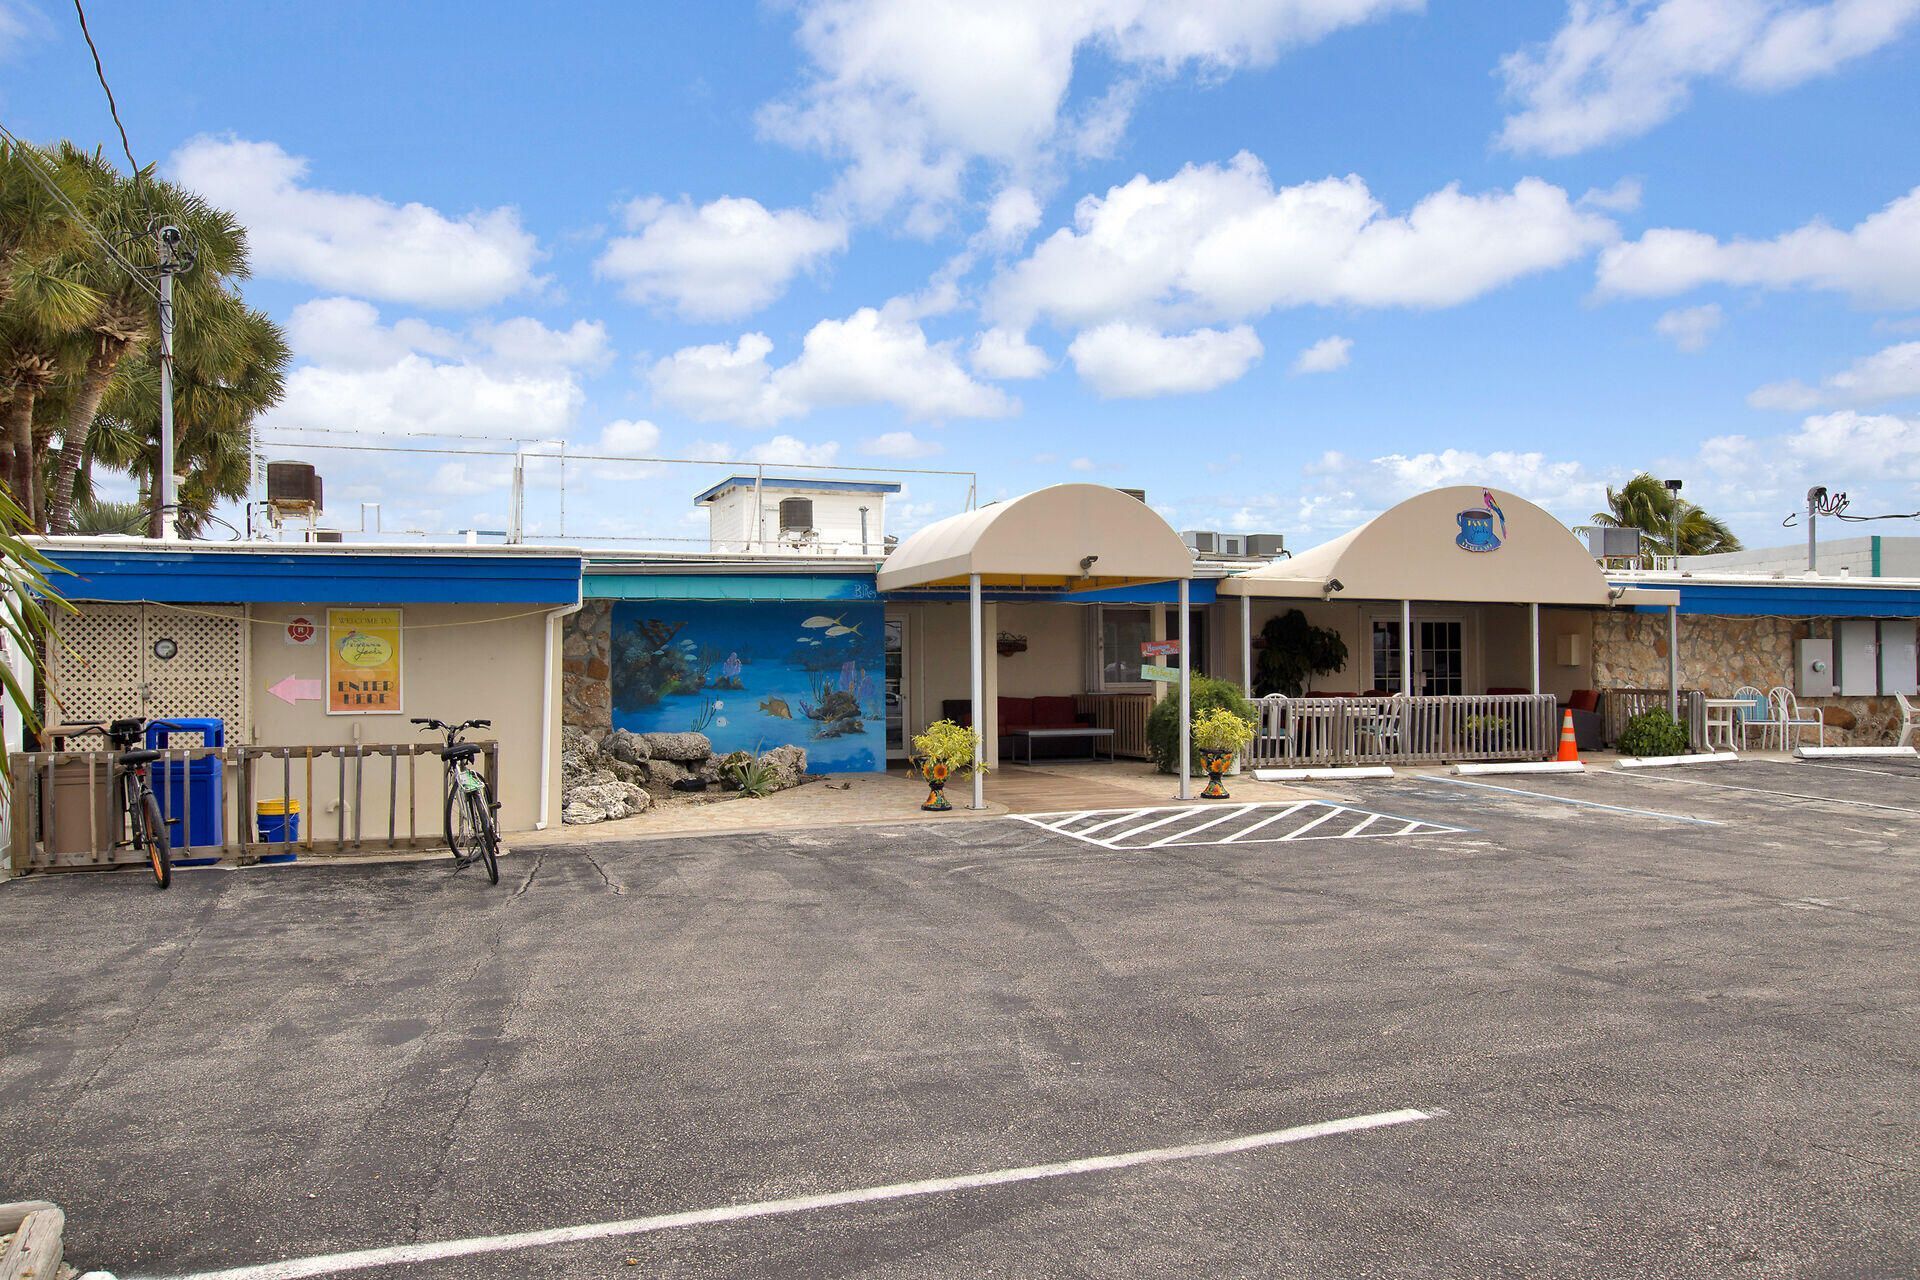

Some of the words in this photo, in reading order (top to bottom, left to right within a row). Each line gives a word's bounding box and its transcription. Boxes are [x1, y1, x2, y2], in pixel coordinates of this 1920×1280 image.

[338, 617, 378, 625] WELCOME
[380, 617, 392, 625] TO
[338, 681, 394, 691] ENTER
[343, 693, 389, 704] HERE
